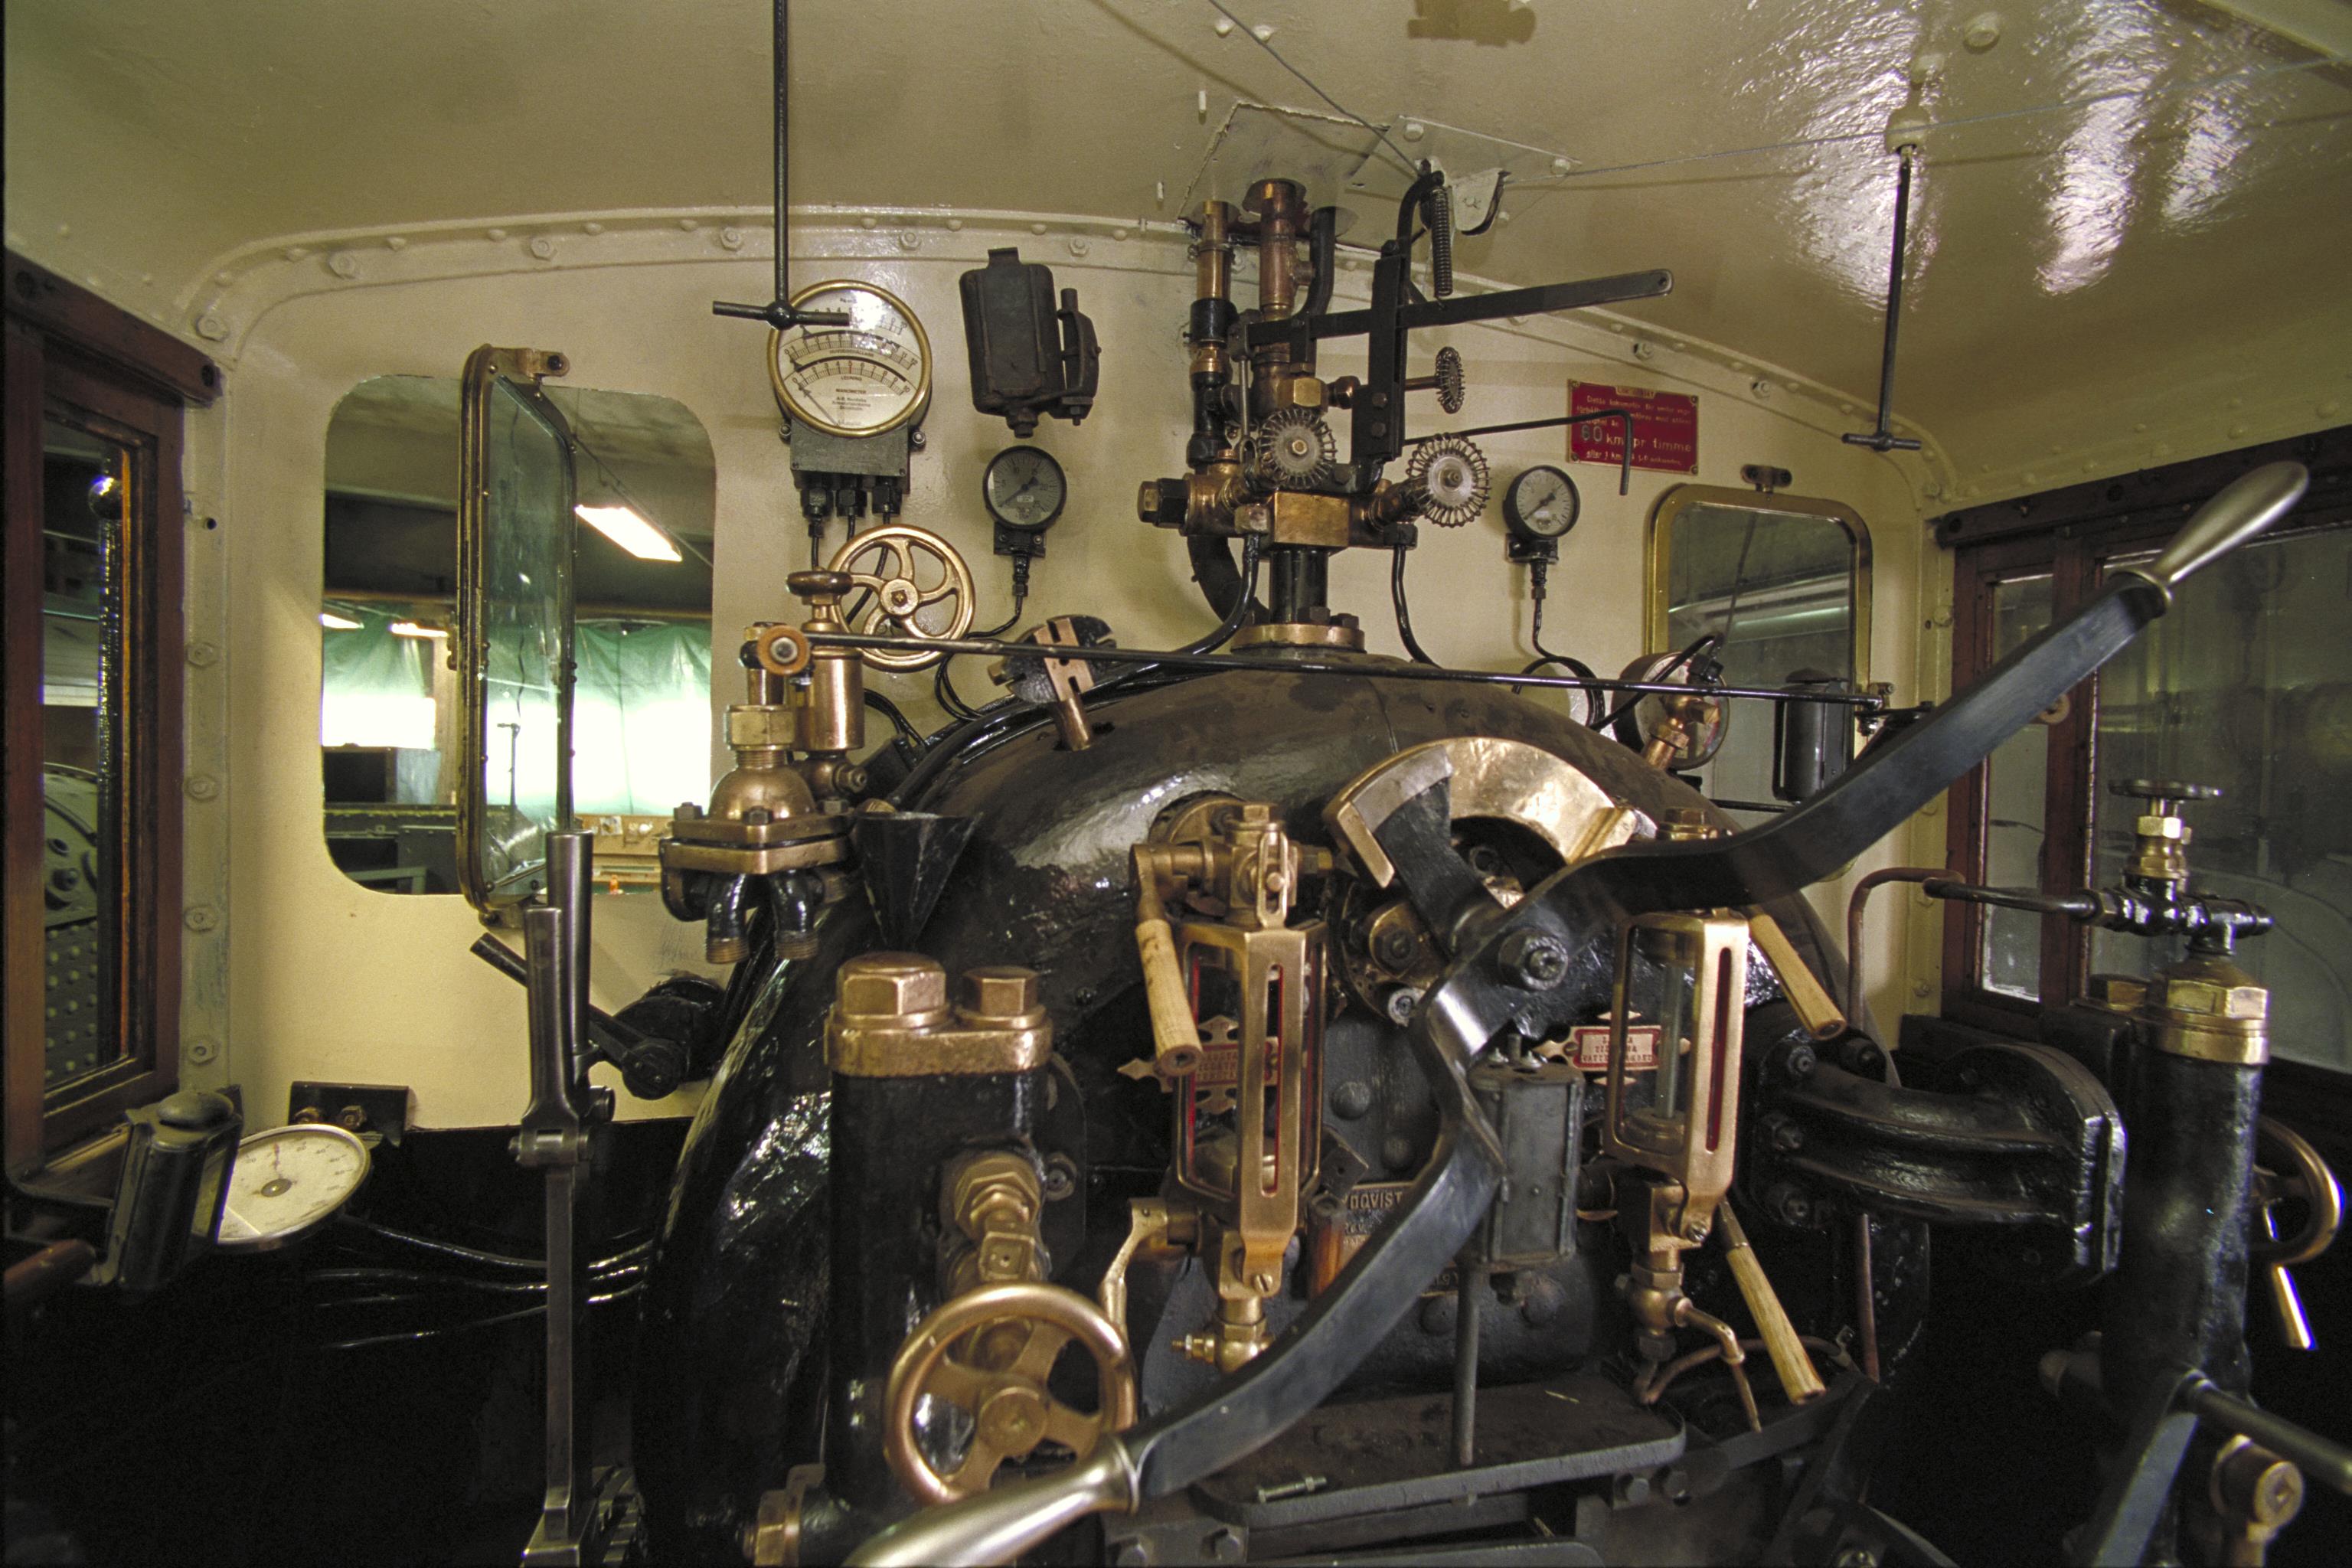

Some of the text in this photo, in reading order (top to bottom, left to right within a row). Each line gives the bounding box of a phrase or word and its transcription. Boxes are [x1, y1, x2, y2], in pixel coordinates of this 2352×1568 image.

[1581, 424, 1603, 443] 60
[1606, 433, 1625, 446] km
[1652, 437, 1691, 452] timme
